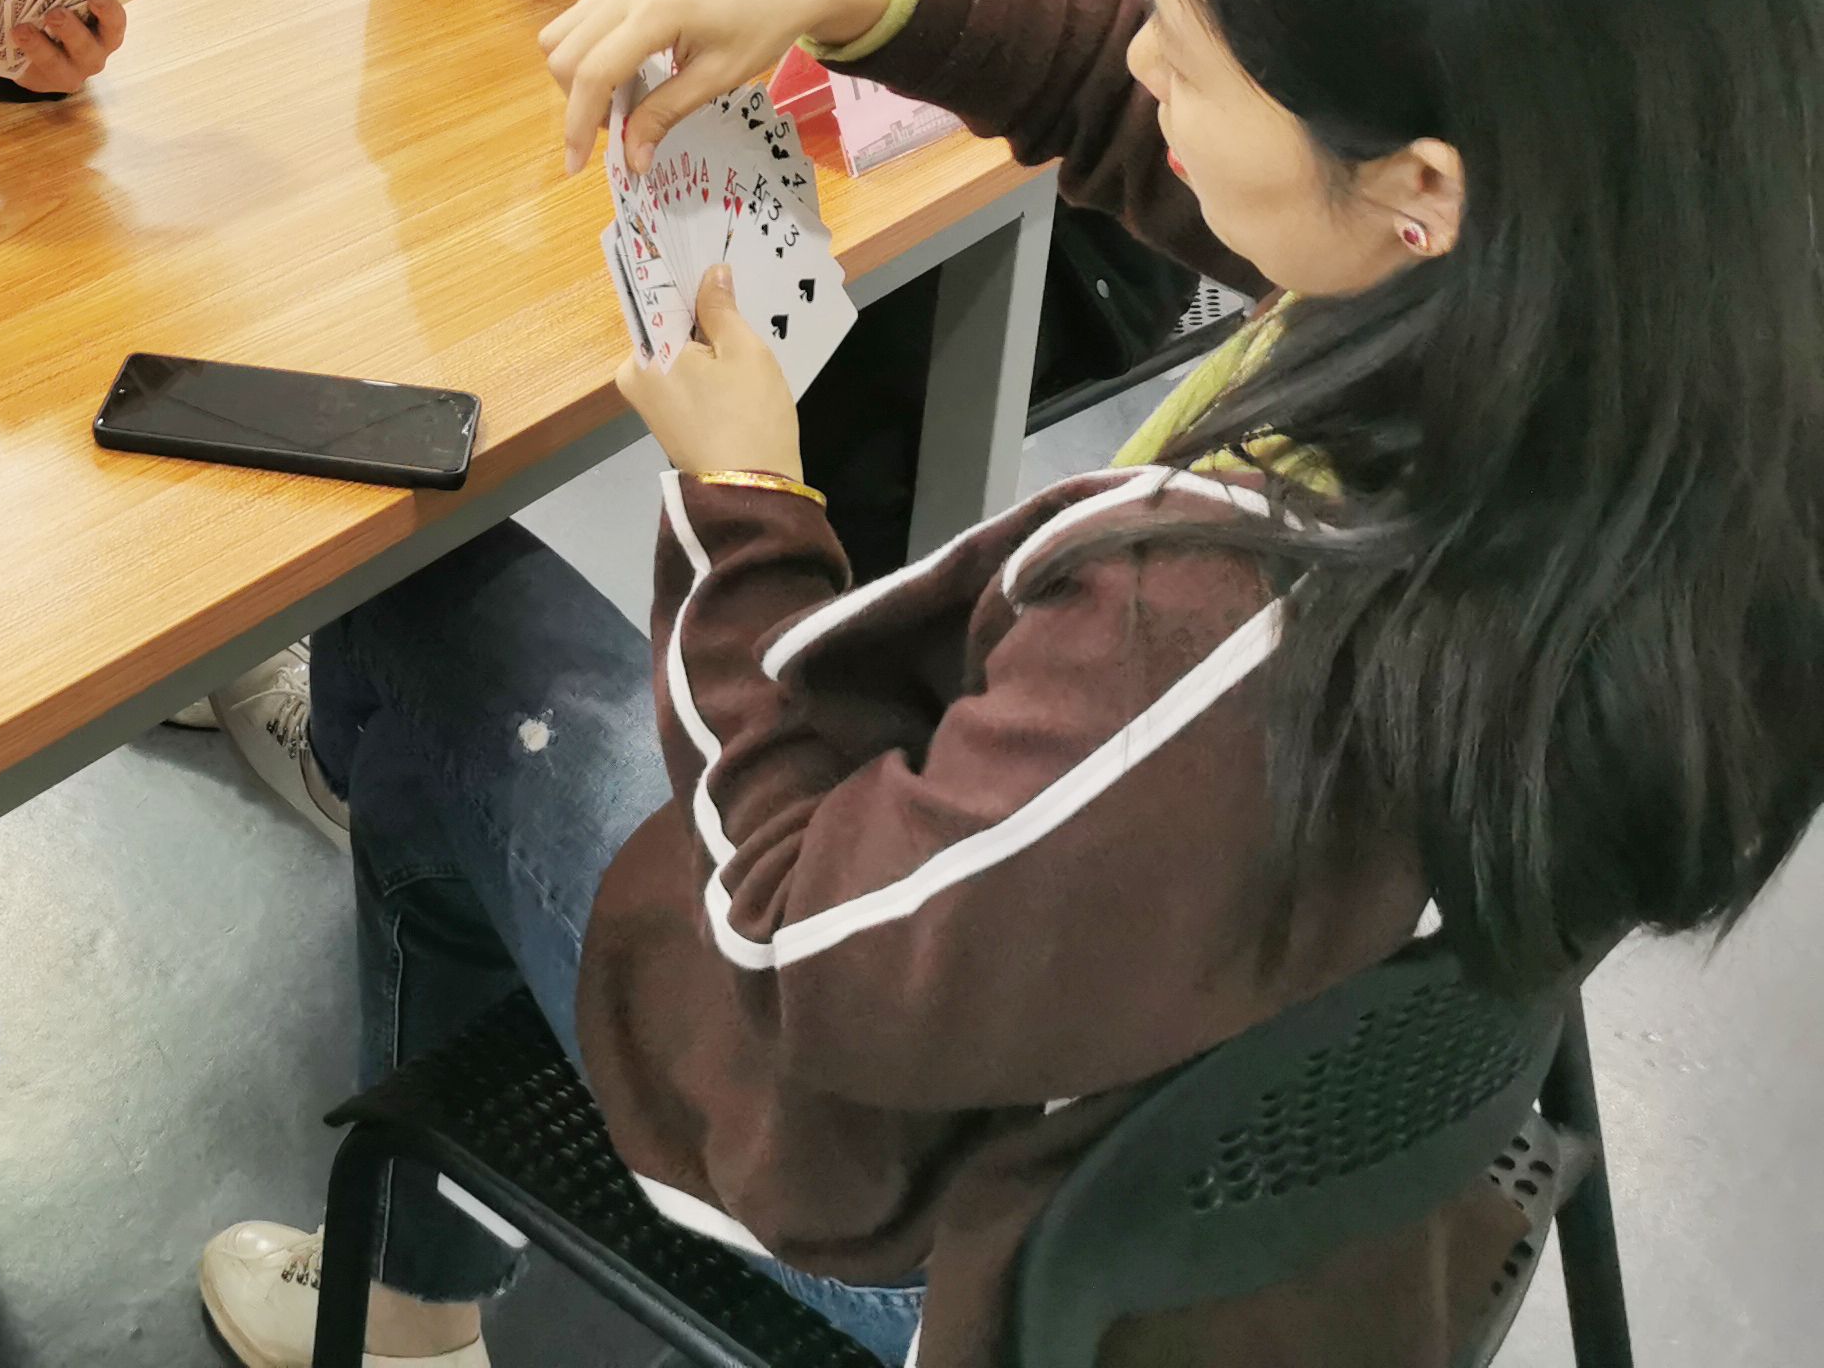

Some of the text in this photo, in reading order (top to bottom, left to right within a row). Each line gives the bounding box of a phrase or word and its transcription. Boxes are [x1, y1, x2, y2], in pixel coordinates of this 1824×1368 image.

[750, 92, 764, 111] 6
[775, 121, 790, 138] 5
[701, 157, 709, 183] A
[725, 167, 737, 196] K
[792, 172, 807, 188] 4
[753, 173, 768, 201] K
[768, 197, 782, 220] 3
[784, 224, 800, 247] 3
